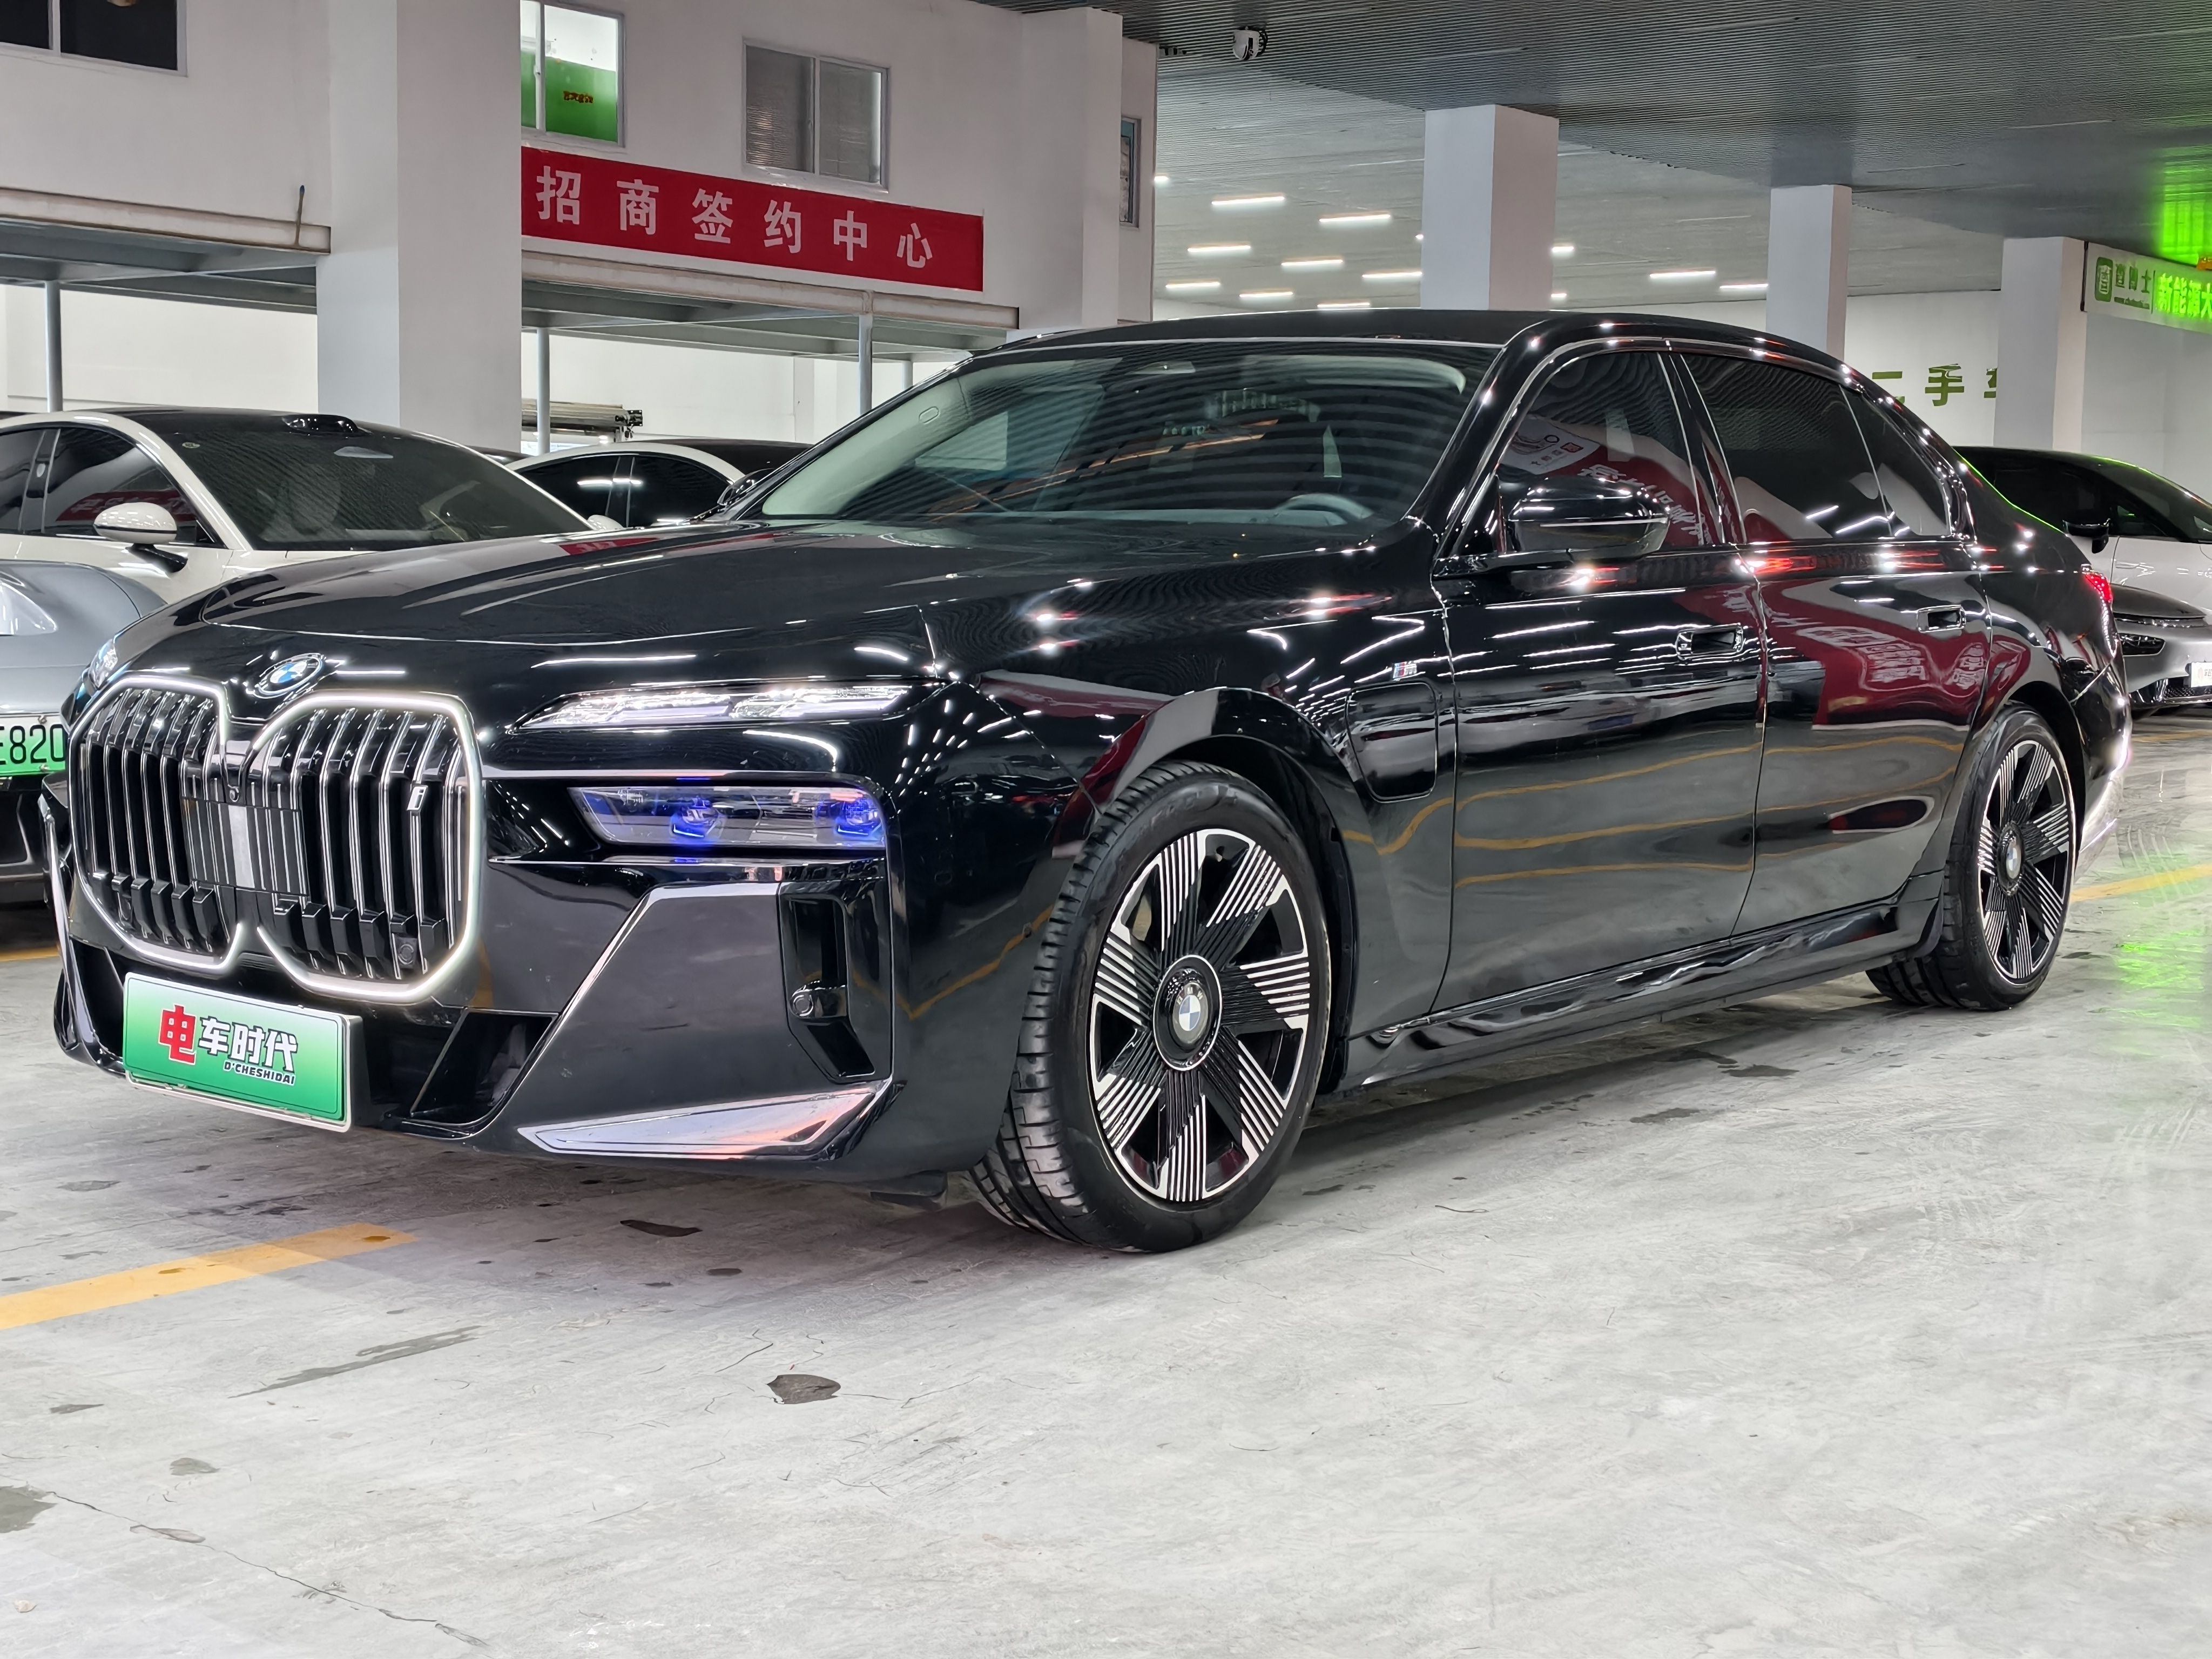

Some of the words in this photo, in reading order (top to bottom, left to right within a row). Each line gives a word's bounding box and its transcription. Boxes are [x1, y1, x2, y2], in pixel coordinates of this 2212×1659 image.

[536, 166, 933, 269] 招商签约中心
[1176, 987, 1204, 1006] BMW
[159, 1004, 298, 1074] 电车时代
[224, 1061, 295, 1085] D'CHESHIDAI
